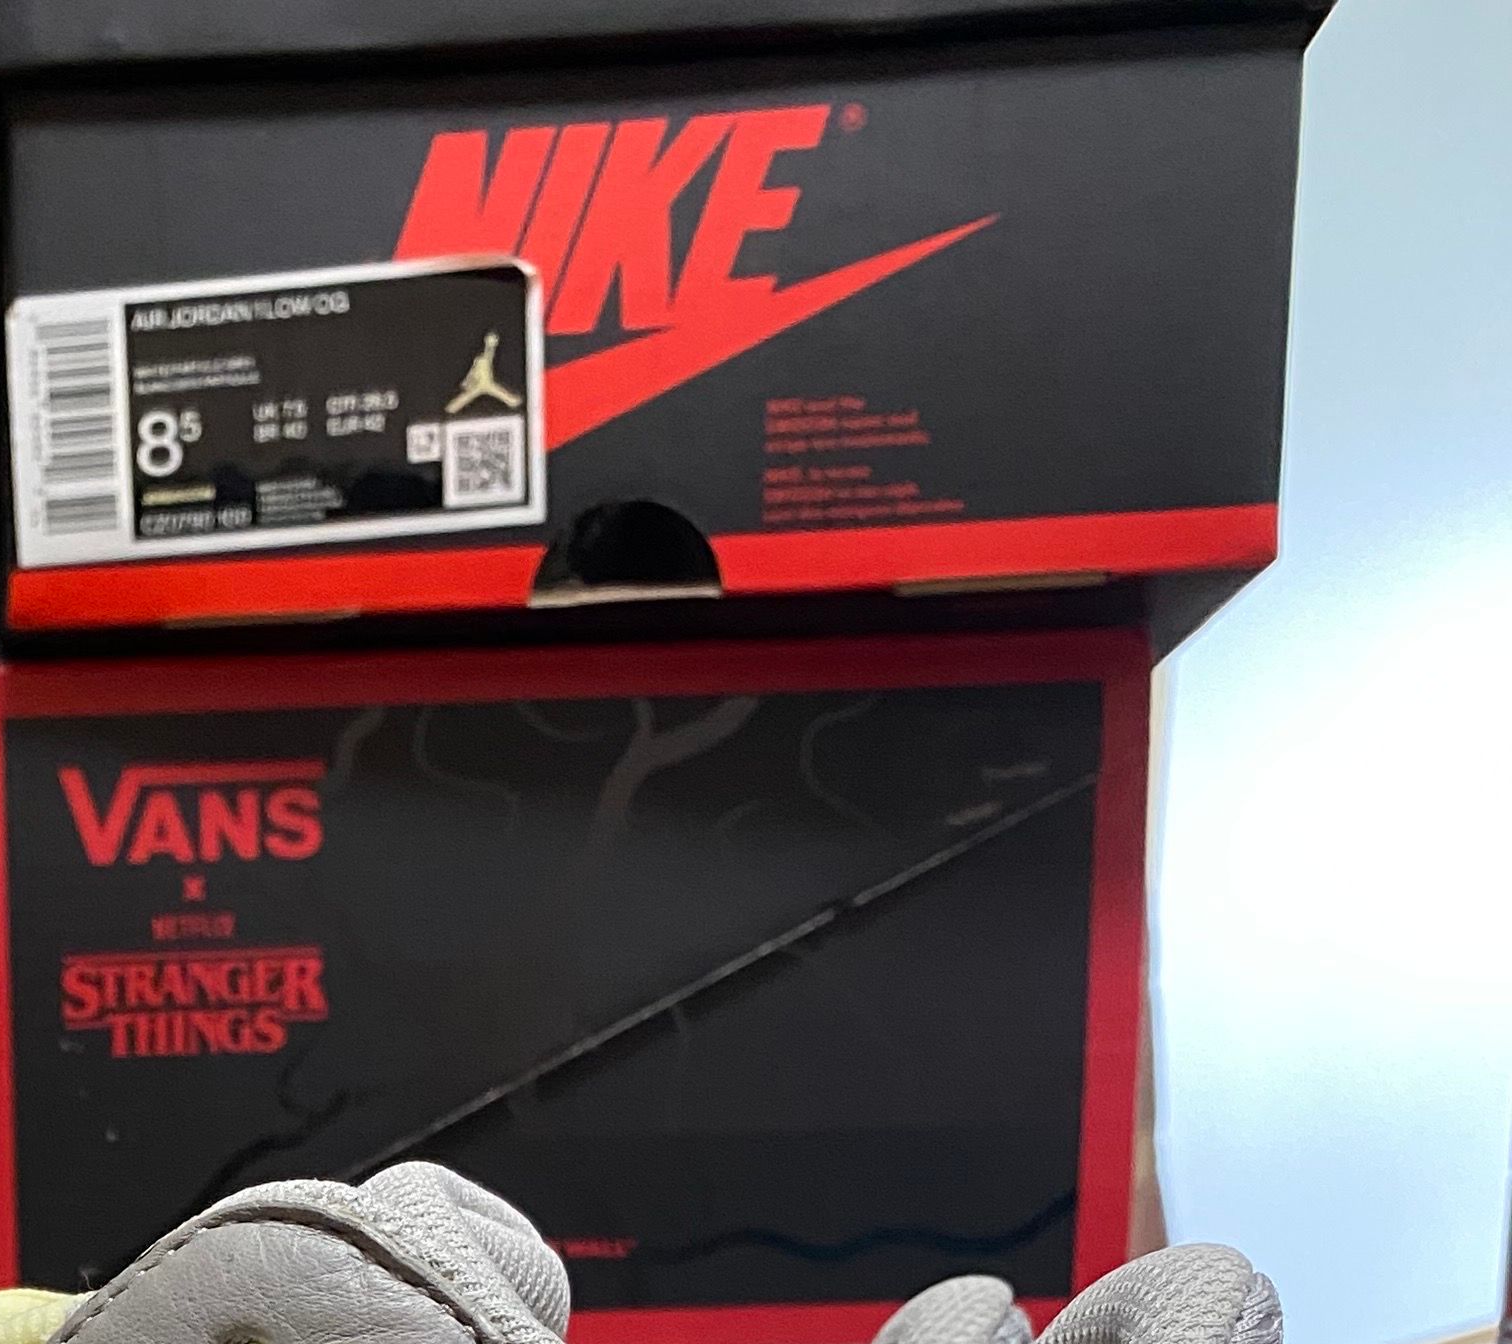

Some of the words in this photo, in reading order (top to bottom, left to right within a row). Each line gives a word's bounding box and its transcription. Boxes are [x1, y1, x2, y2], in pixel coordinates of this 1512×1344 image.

[393, 104, 831, 335] NIKE
[57, 757, 327, 867] VANS
[60, 950, 329, 1024] STRANGER
[110, 1011, 288, 1058] THINGS
